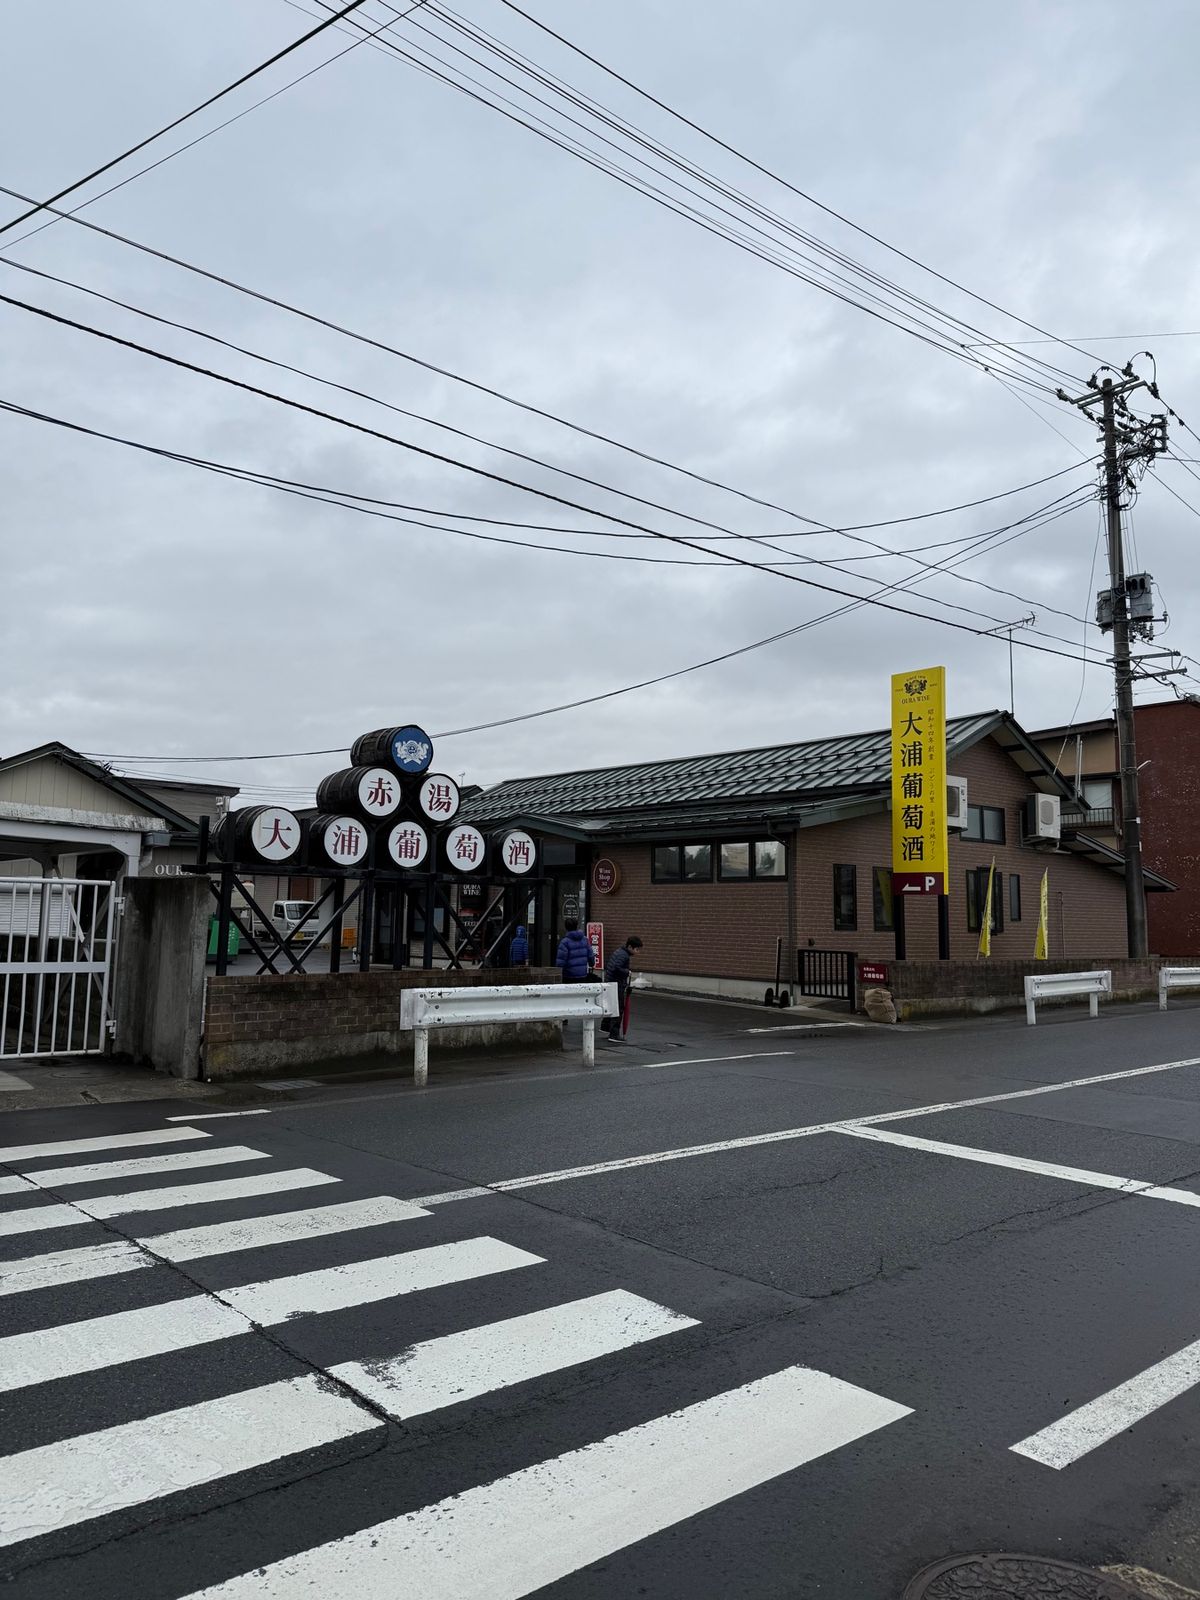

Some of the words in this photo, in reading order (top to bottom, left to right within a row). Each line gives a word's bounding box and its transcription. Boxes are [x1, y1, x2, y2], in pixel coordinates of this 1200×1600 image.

[367, 777, 453, 814] 赤湯
[900, 711, 924, 862] 大浦葡萄酒
[260, 818, 531, 868] 大浦葡萄酒
[155, 865, 193, 876] OUR
[925, 876, 936, 892] P
